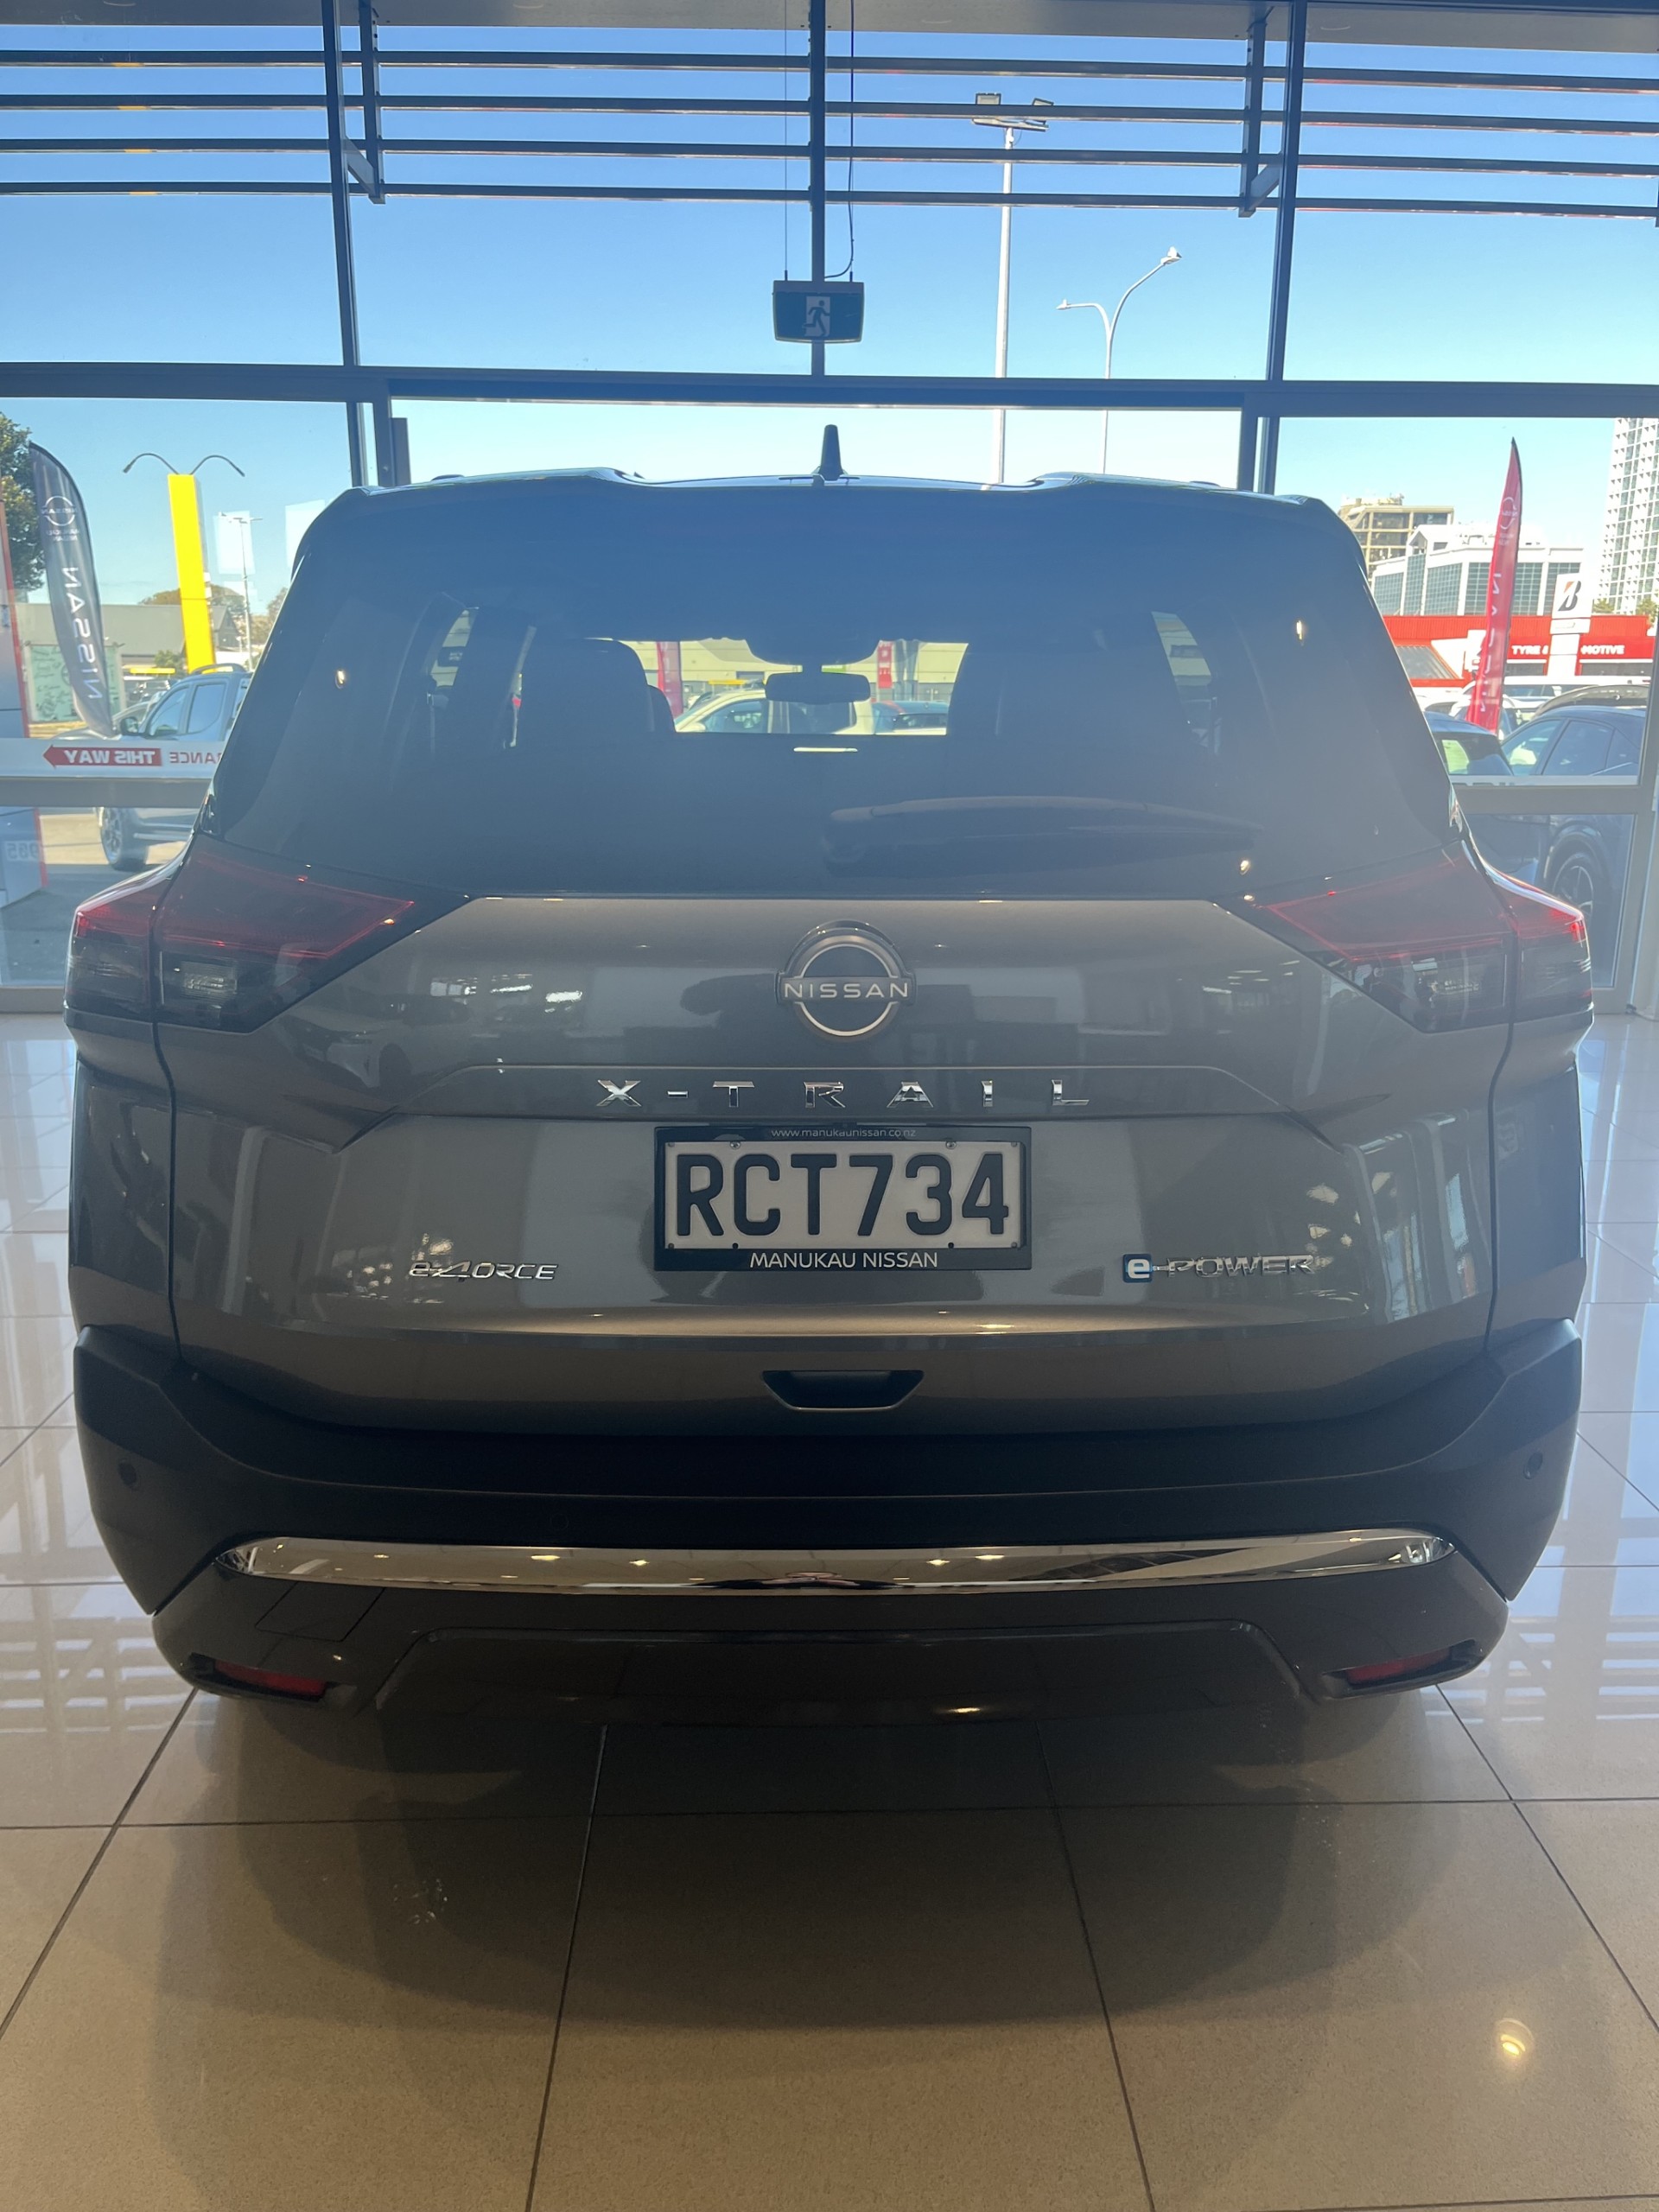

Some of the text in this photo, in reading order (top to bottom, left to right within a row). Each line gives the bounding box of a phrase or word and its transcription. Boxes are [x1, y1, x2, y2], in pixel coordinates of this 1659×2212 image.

[1511, 645, 1541, 655] TYRE
[784, 982, 908, 999] NISSAN
[596, 1079, 1090, 1109] X-TRAIL
[771, 1128, 917, 1139] www.manukaunissan.co.nz
[676, 1153, 1010, 1236] RCT734
[749, 1252, 938, 1268] MANUKAU NISSAN
[1126, 1255, 1315, 1279] e-POWER
